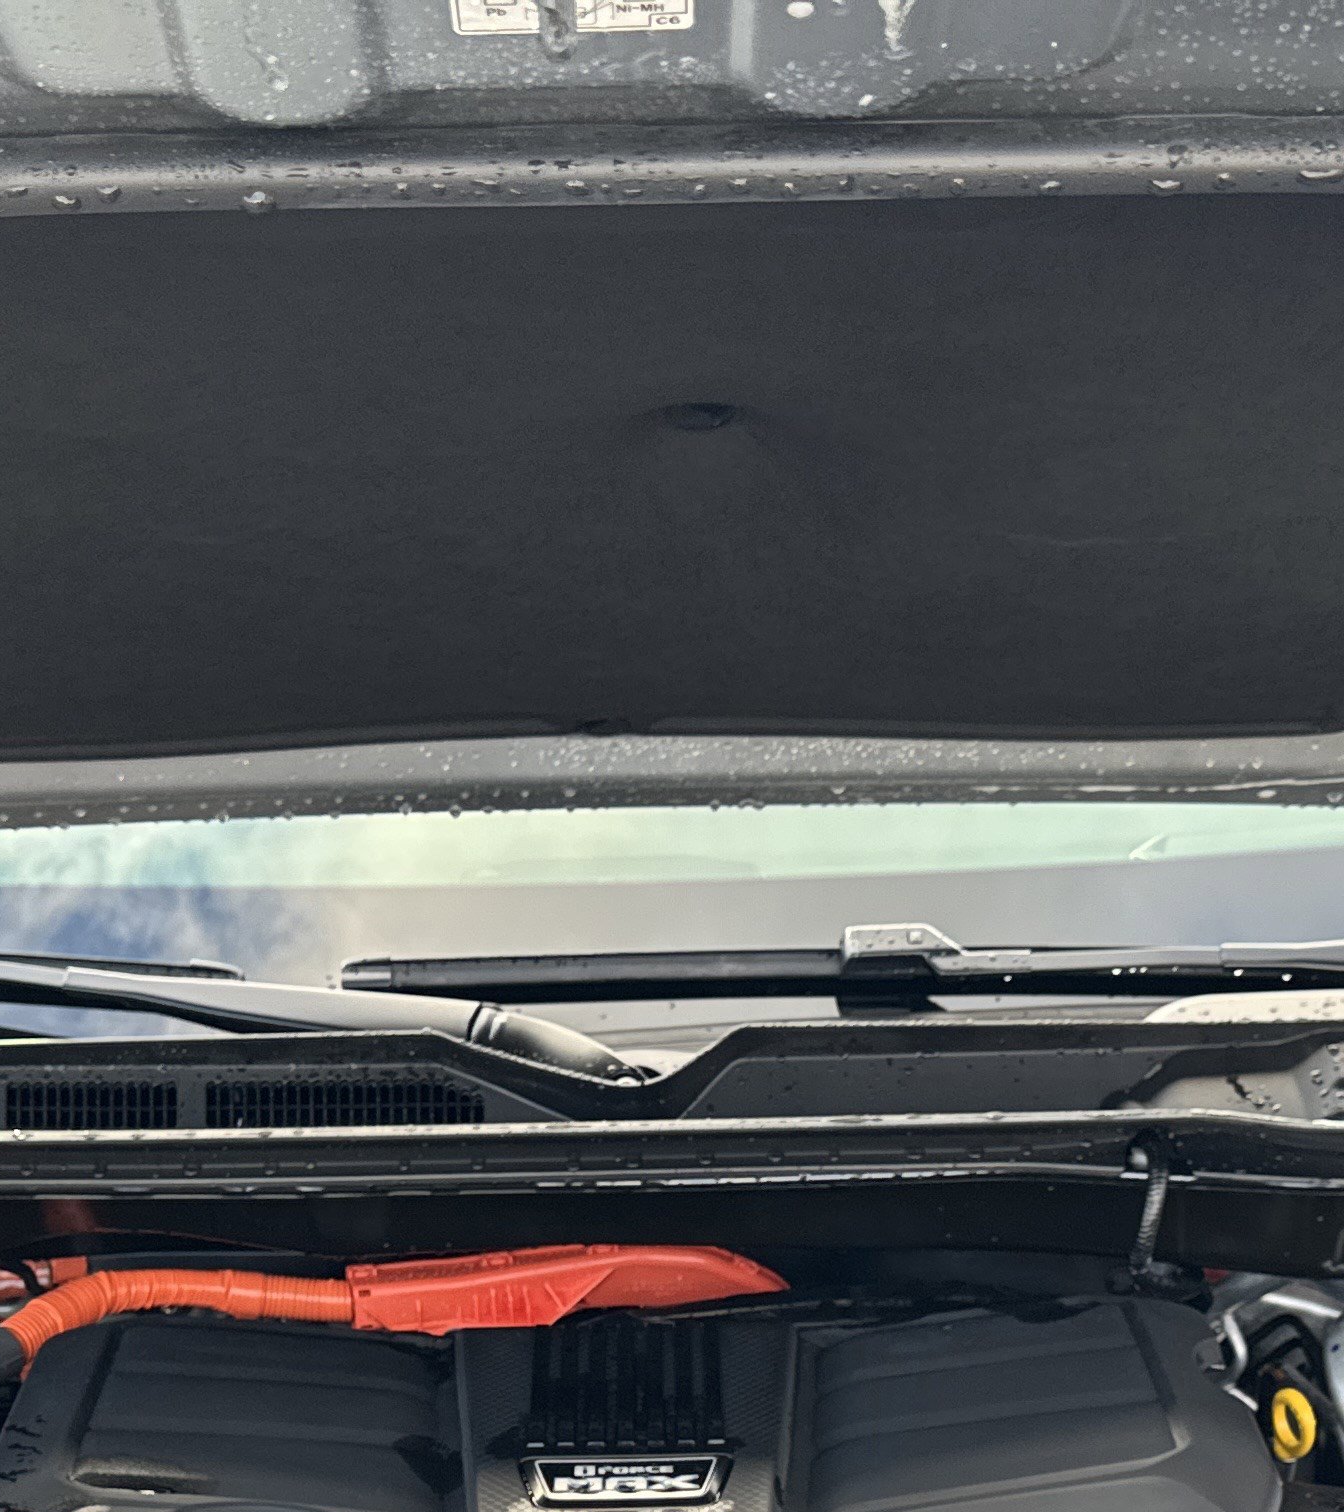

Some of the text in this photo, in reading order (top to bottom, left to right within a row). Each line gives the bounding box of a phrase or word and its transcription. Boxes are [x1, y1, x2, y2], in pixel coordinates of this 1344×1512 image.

[485, 7, 507, 17] Pb
[615, 3, 665, 13] Ni-MH
[655, 16, 681, 25] C6
[553, 1474, 700, 1493] MAX
